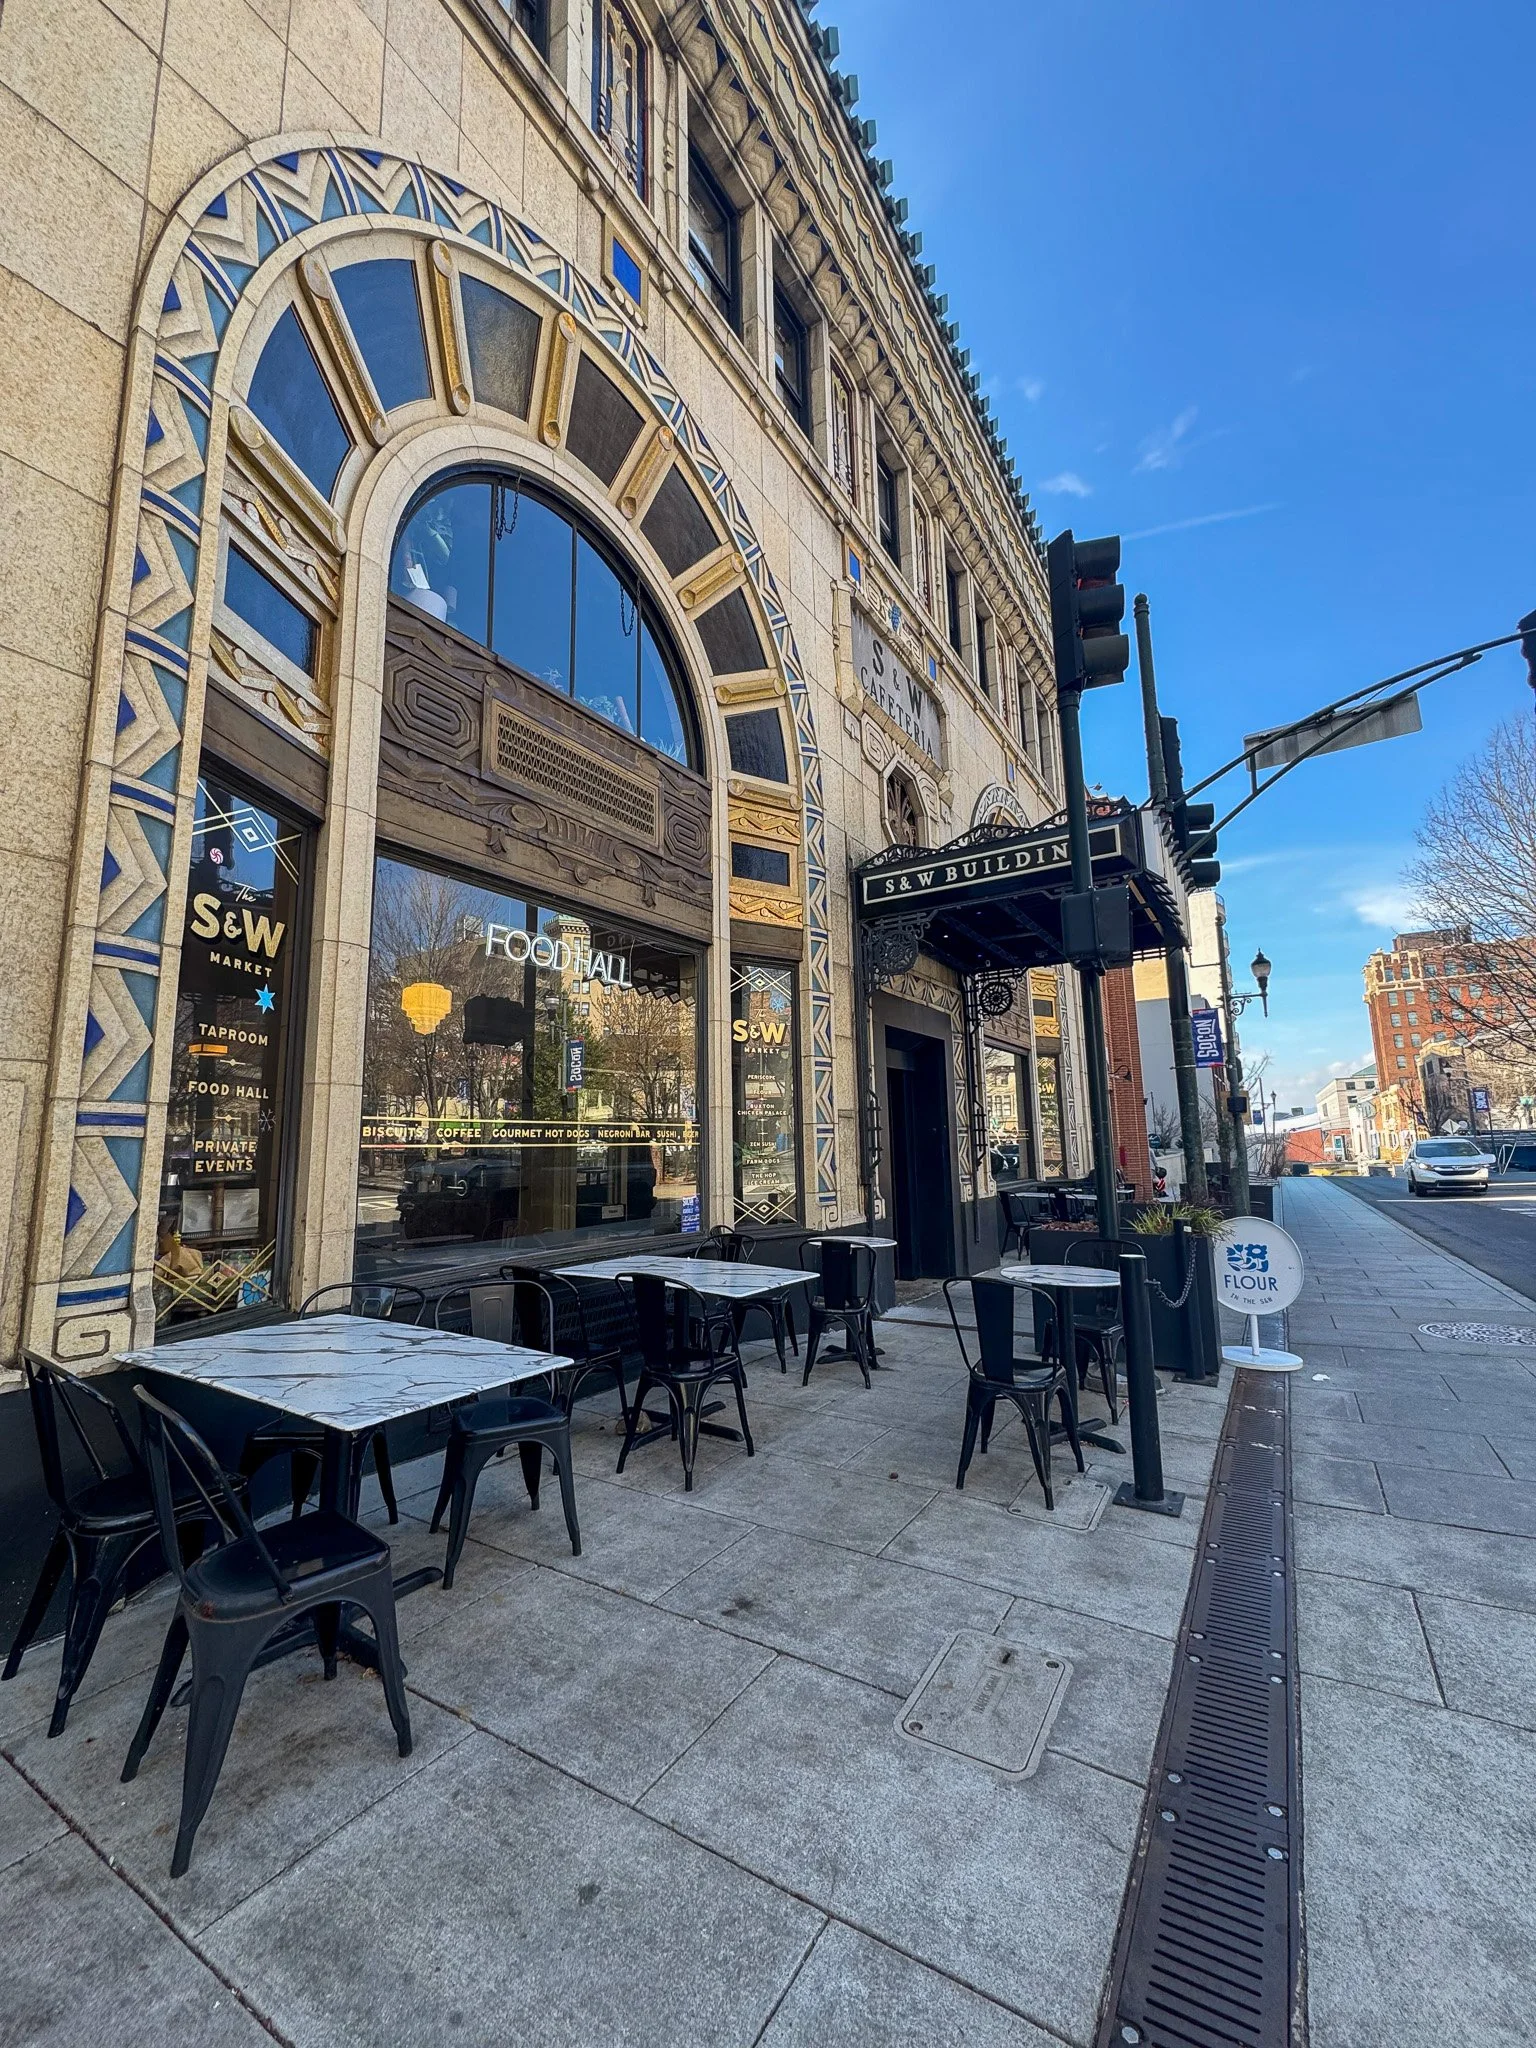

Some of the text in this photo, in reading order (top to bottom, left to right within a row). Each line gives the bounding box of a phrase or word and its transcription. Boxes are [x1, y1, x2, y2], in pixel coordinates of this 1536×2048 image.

[872, 639, 923, 719] S & W
[860, 666, 934, 760] CAFETERIA
[944, 842, 1069, 883] BUILDIN
[234, 881, 259, 902] The
[190, 892, 286, 959] S&W
[209, 951, 273, 978] MARKET
[485, 922, 633, 989] FOOD HALL
[198, 1022, 269, 1047] TAPROOM
[732, 1019, 786, 1044] S&W
[744, 1046, 781, 1055] MARKET
[187, 1080, 270, 1100] FOOD HALL
[362, 1126, 424, 1138] BISCUITS
[436, 1127, 482, 1138] COFFEE
[492, 1128, 543, 1138] GOURMET
[544, 1129, 565, 1138] HOT
[566, 1129, 590, 1138] DOGS
[597, 1130, 634, 1138] NEGRONI
[635, 1130, 651, 1138] BAR
[194, 1140, 258, 1154] PRIVATE
[194, 1159, 254, 1173] EVENTS
[1223, 1274, 1279, 1292] FLOUR
[1230, 1292, 1240, 1301] IN
[1243, 1297, 1256, 1305] THE
